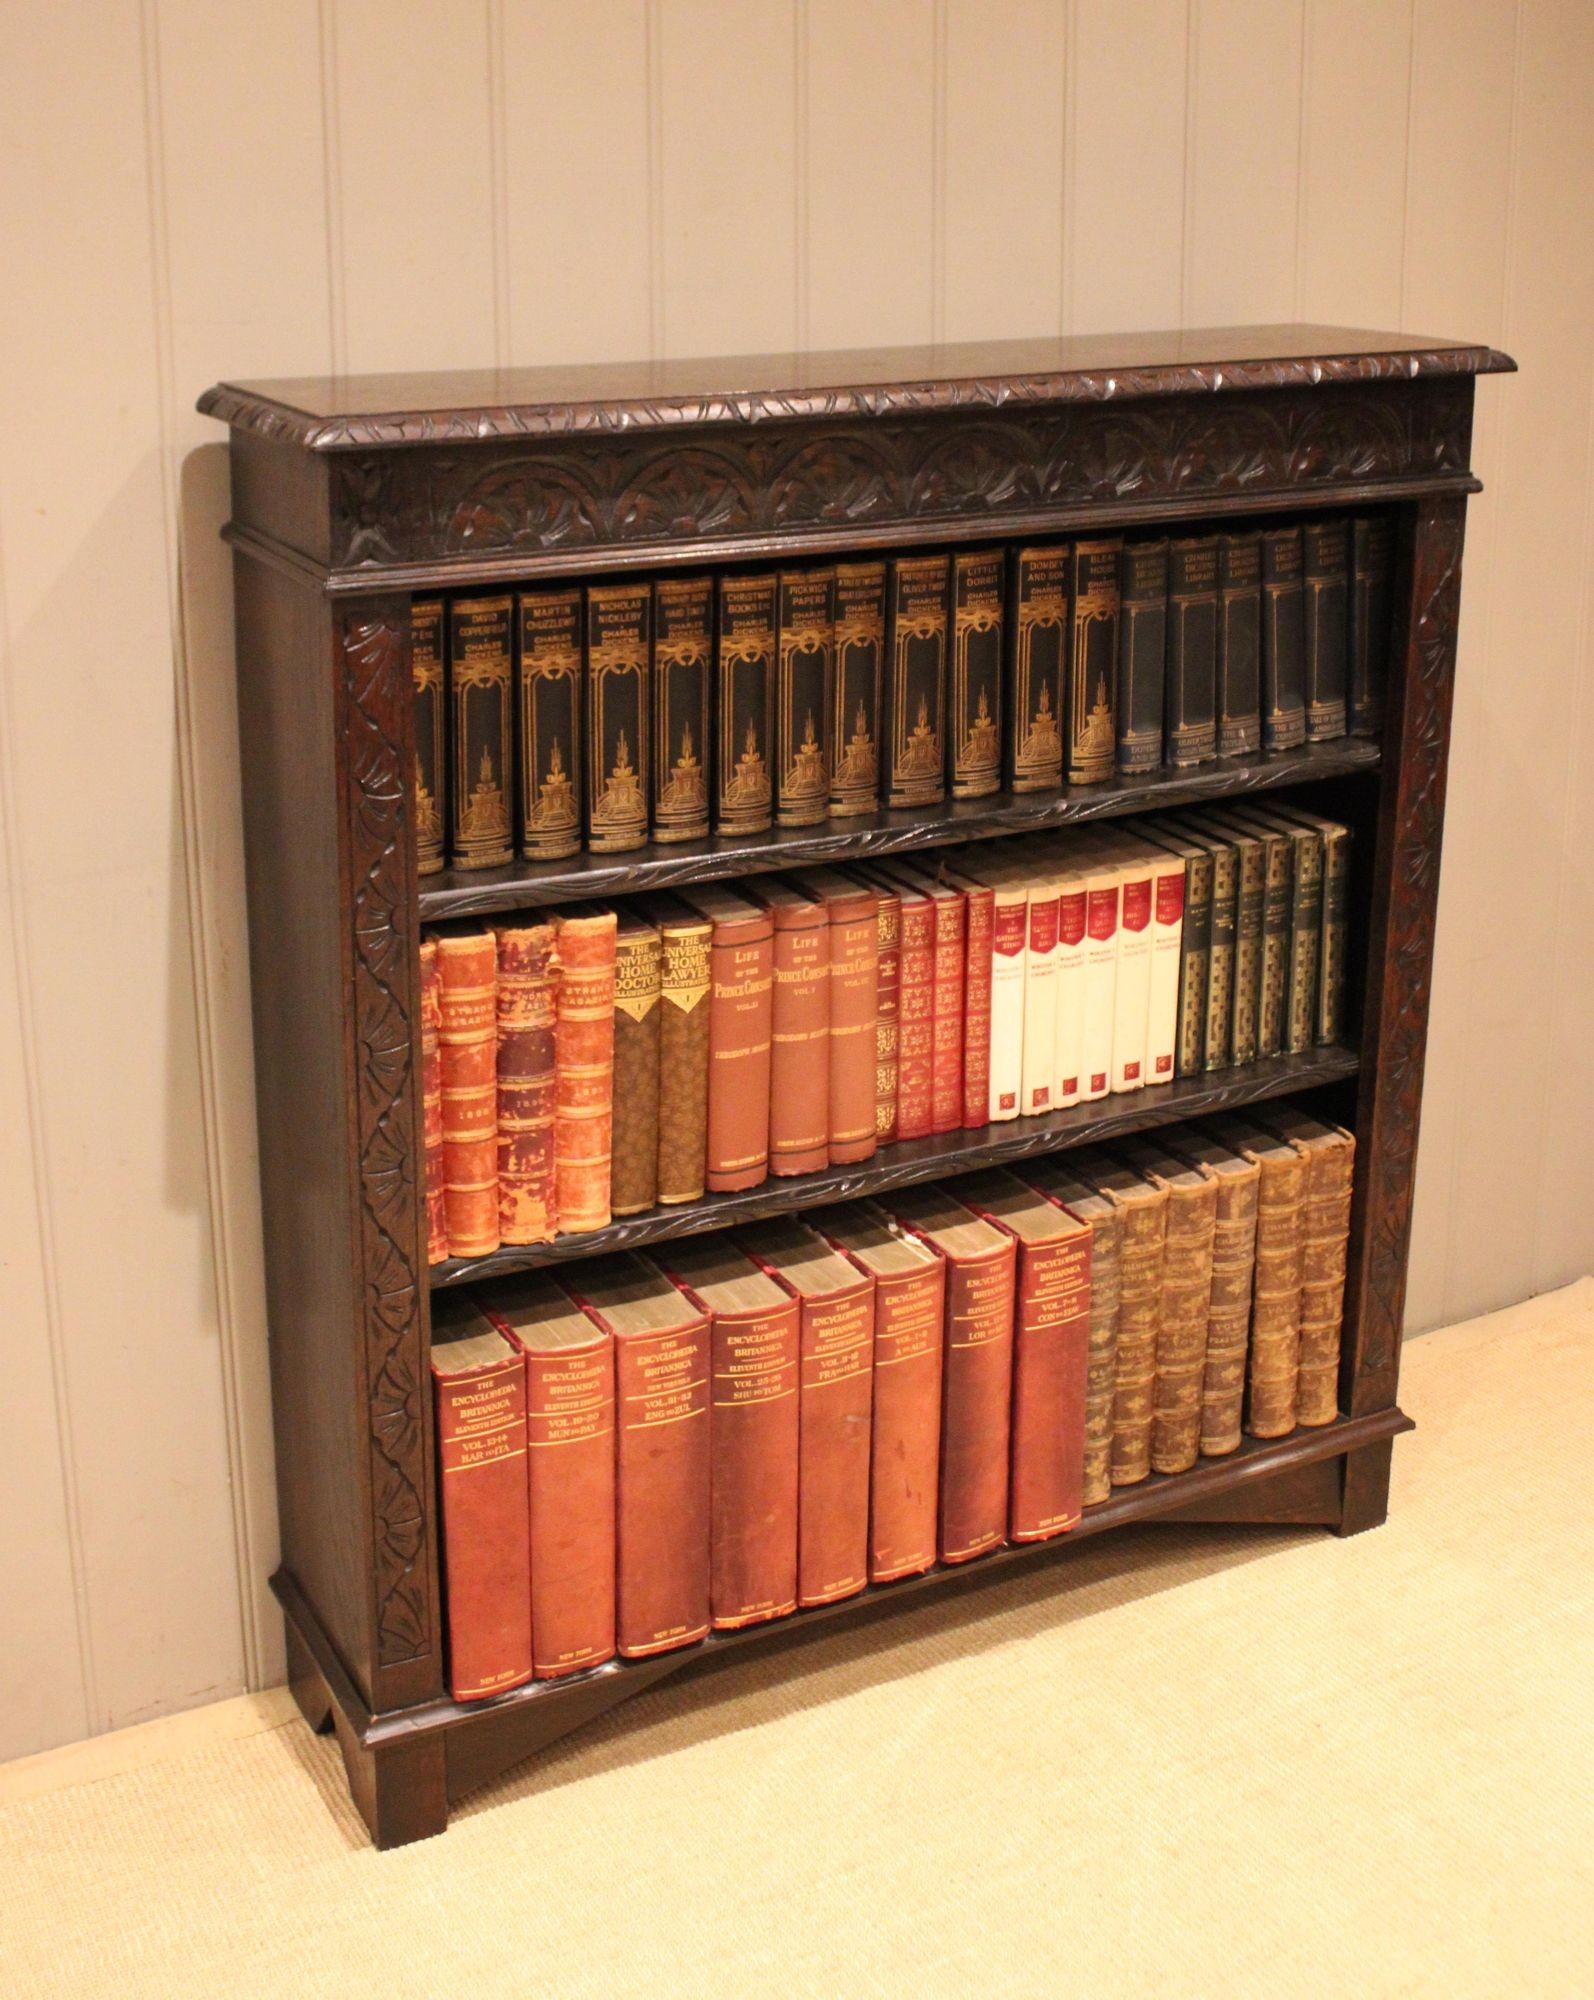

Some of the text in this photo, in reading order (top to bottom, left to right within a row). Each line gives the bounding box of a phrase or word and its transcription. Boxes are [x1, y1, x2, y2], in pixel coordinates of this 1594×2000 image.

[967, 565, 997, 576] LITTLE
[1030, 560, 1064, 571] DOMBEY
[966, 575, 998, 587] DORRIT
[1028, 570, 1065, 581] AND SON
[789, 583, 828, 594] PICKWICK
[599, 600, 641, 610] NICHOLAS
[792, 594, 826, 606] PAPERS
[533, 605, 570, 617] MARTIN
[728, 603, 757, 614] BOOKS
[472, 612, 498, 623] DAVID
[526, 616, 576, 630] CHUZZLEWIT
[598, 612, 642, 624] NICKLEBY
[602, 628, 639, 638] CHARLES
[678, 936, 699, 946] THE
[846, 930, 869, 942] LIFE
[792, 938, 818, 949] LIFE
[630, 944, 649, 955] THE
[669, 954, 706, 969] HOME
[735, 951, 759, 963] LIFE
[620, 962, 656, 978] HOME
[662, 964, 711, 980] LAWYER
[774, 968, 802, 982] PRINCE
[715, 982, 744, 998] PRINCE
[1056, 1247, 1069, 1255] THE
[1040, 1265, 1081, 1282] BRITANNICA
[908, 1282, 922, 1290] THE
[836, 1302, 850, 1311] THE
[1042, 1302, 1061, 1311] VOL.
[1038, 1314, 1055, 1322] CON
[752, 1324, 768, 1332] THE
[819, 1320, 862, 1338] BRITANNICA
[969, 1331, 986, 1340] LOR
[661, 1340, 677, 1349] THE
[734, 1342, 782, 1357] BRITANNICA
[568, 1361, 586, 1369] THE
[644, 1359, 692, 1377] BRITANNICA
[819, 1370, 836, 1380] FRA
[478, 1381, 494, 1390] THE
[549, 1380, 600, 1395] BRITANNICA
[734, 1380, 756, 1388] VOL.
[460, 1399, 511, 1418] BRITANNICA
[644, 1399, 667, 1409] VOL.
[548, 1419, 572, 1428] VOL.
[462, 1441, 486, 1452] VOL.
